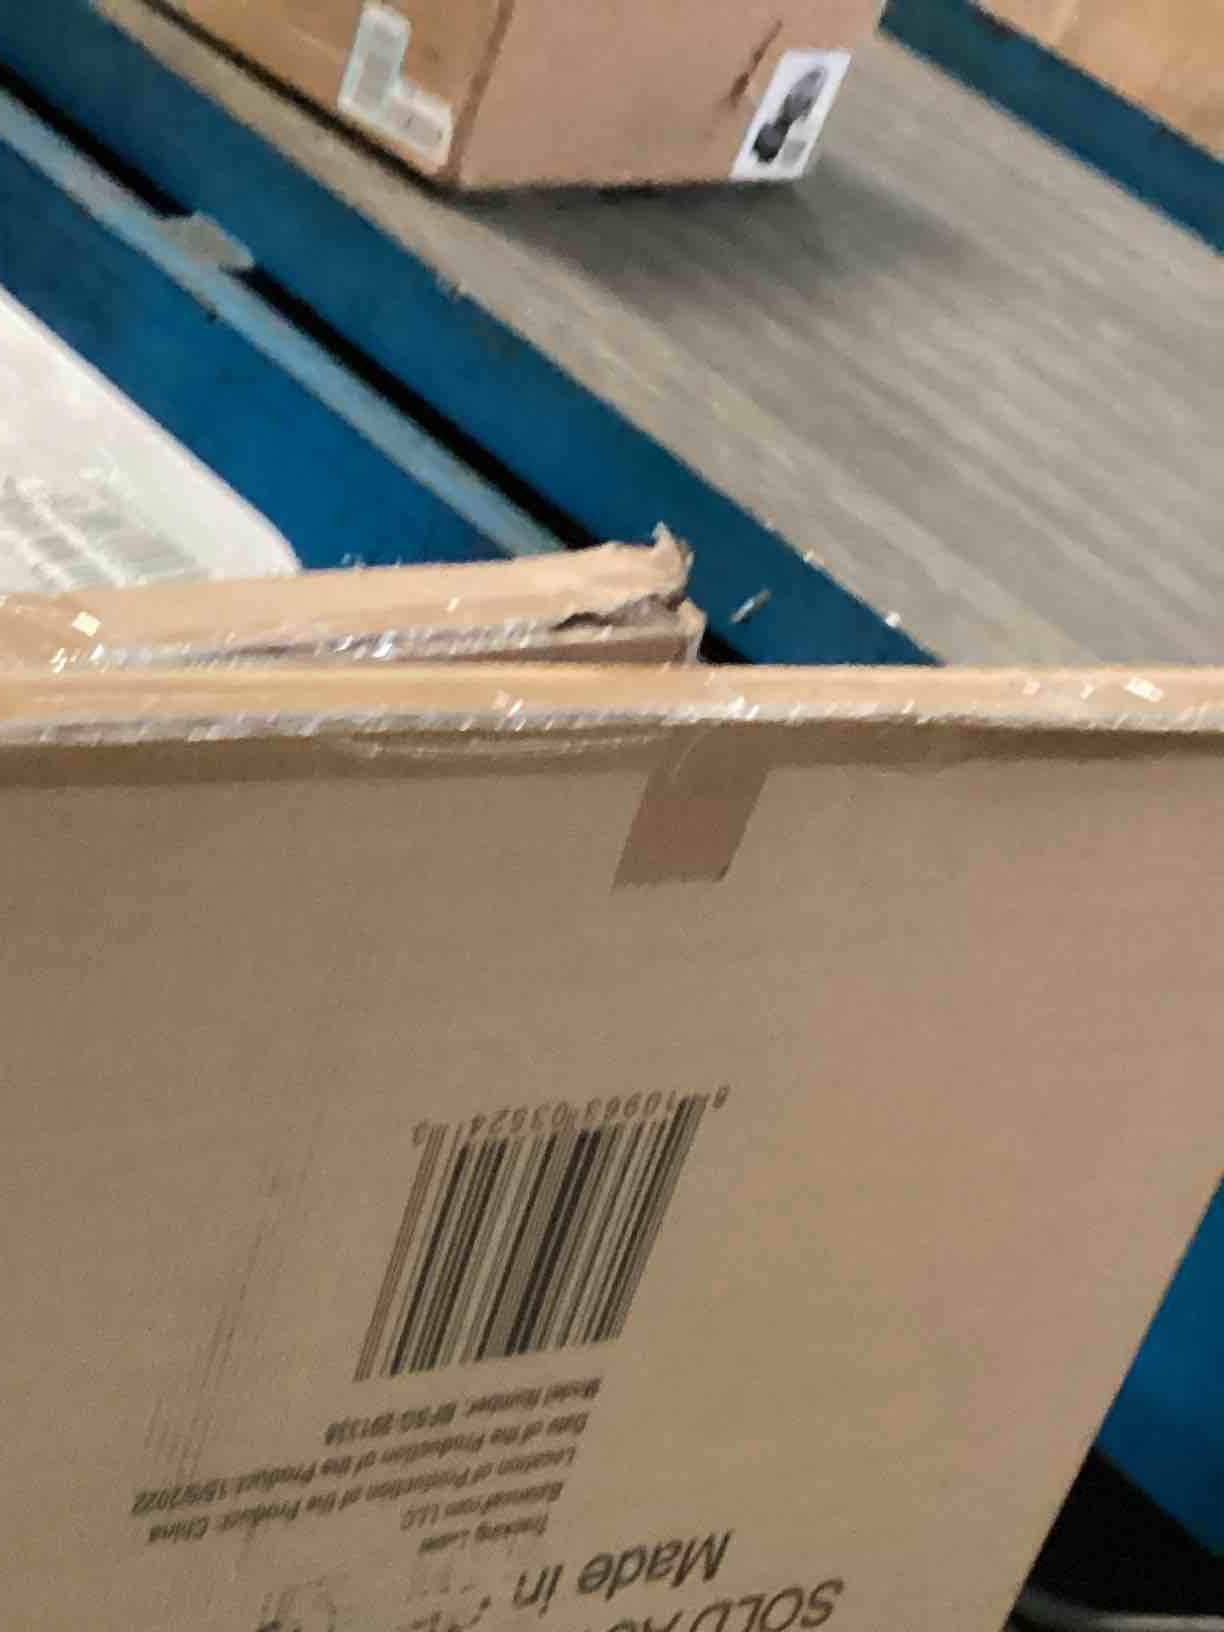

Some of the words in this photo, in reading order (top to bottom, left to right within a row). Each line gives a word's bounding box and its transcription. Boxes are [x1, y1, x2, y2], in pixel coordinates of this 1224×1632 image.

[543, 1379, 601, 1406] Model
[489, 1424, 521, 1447] the
[546, 1413, 588, 1436] Date
[379, 1433, 485, 1464] Production
[497, 1447, 576, 1475] Location
[320, 1456, 352, 1477] the
[365, 1468, 470, 1502] Production
[305, 1493, 337, 1517] the
[400, 1504, 440, 1532] LLC
[145, 1517, 210, 1545] China
[575, 1530, 732, 1603] Made
[512, 1566, 564, 1627] in
